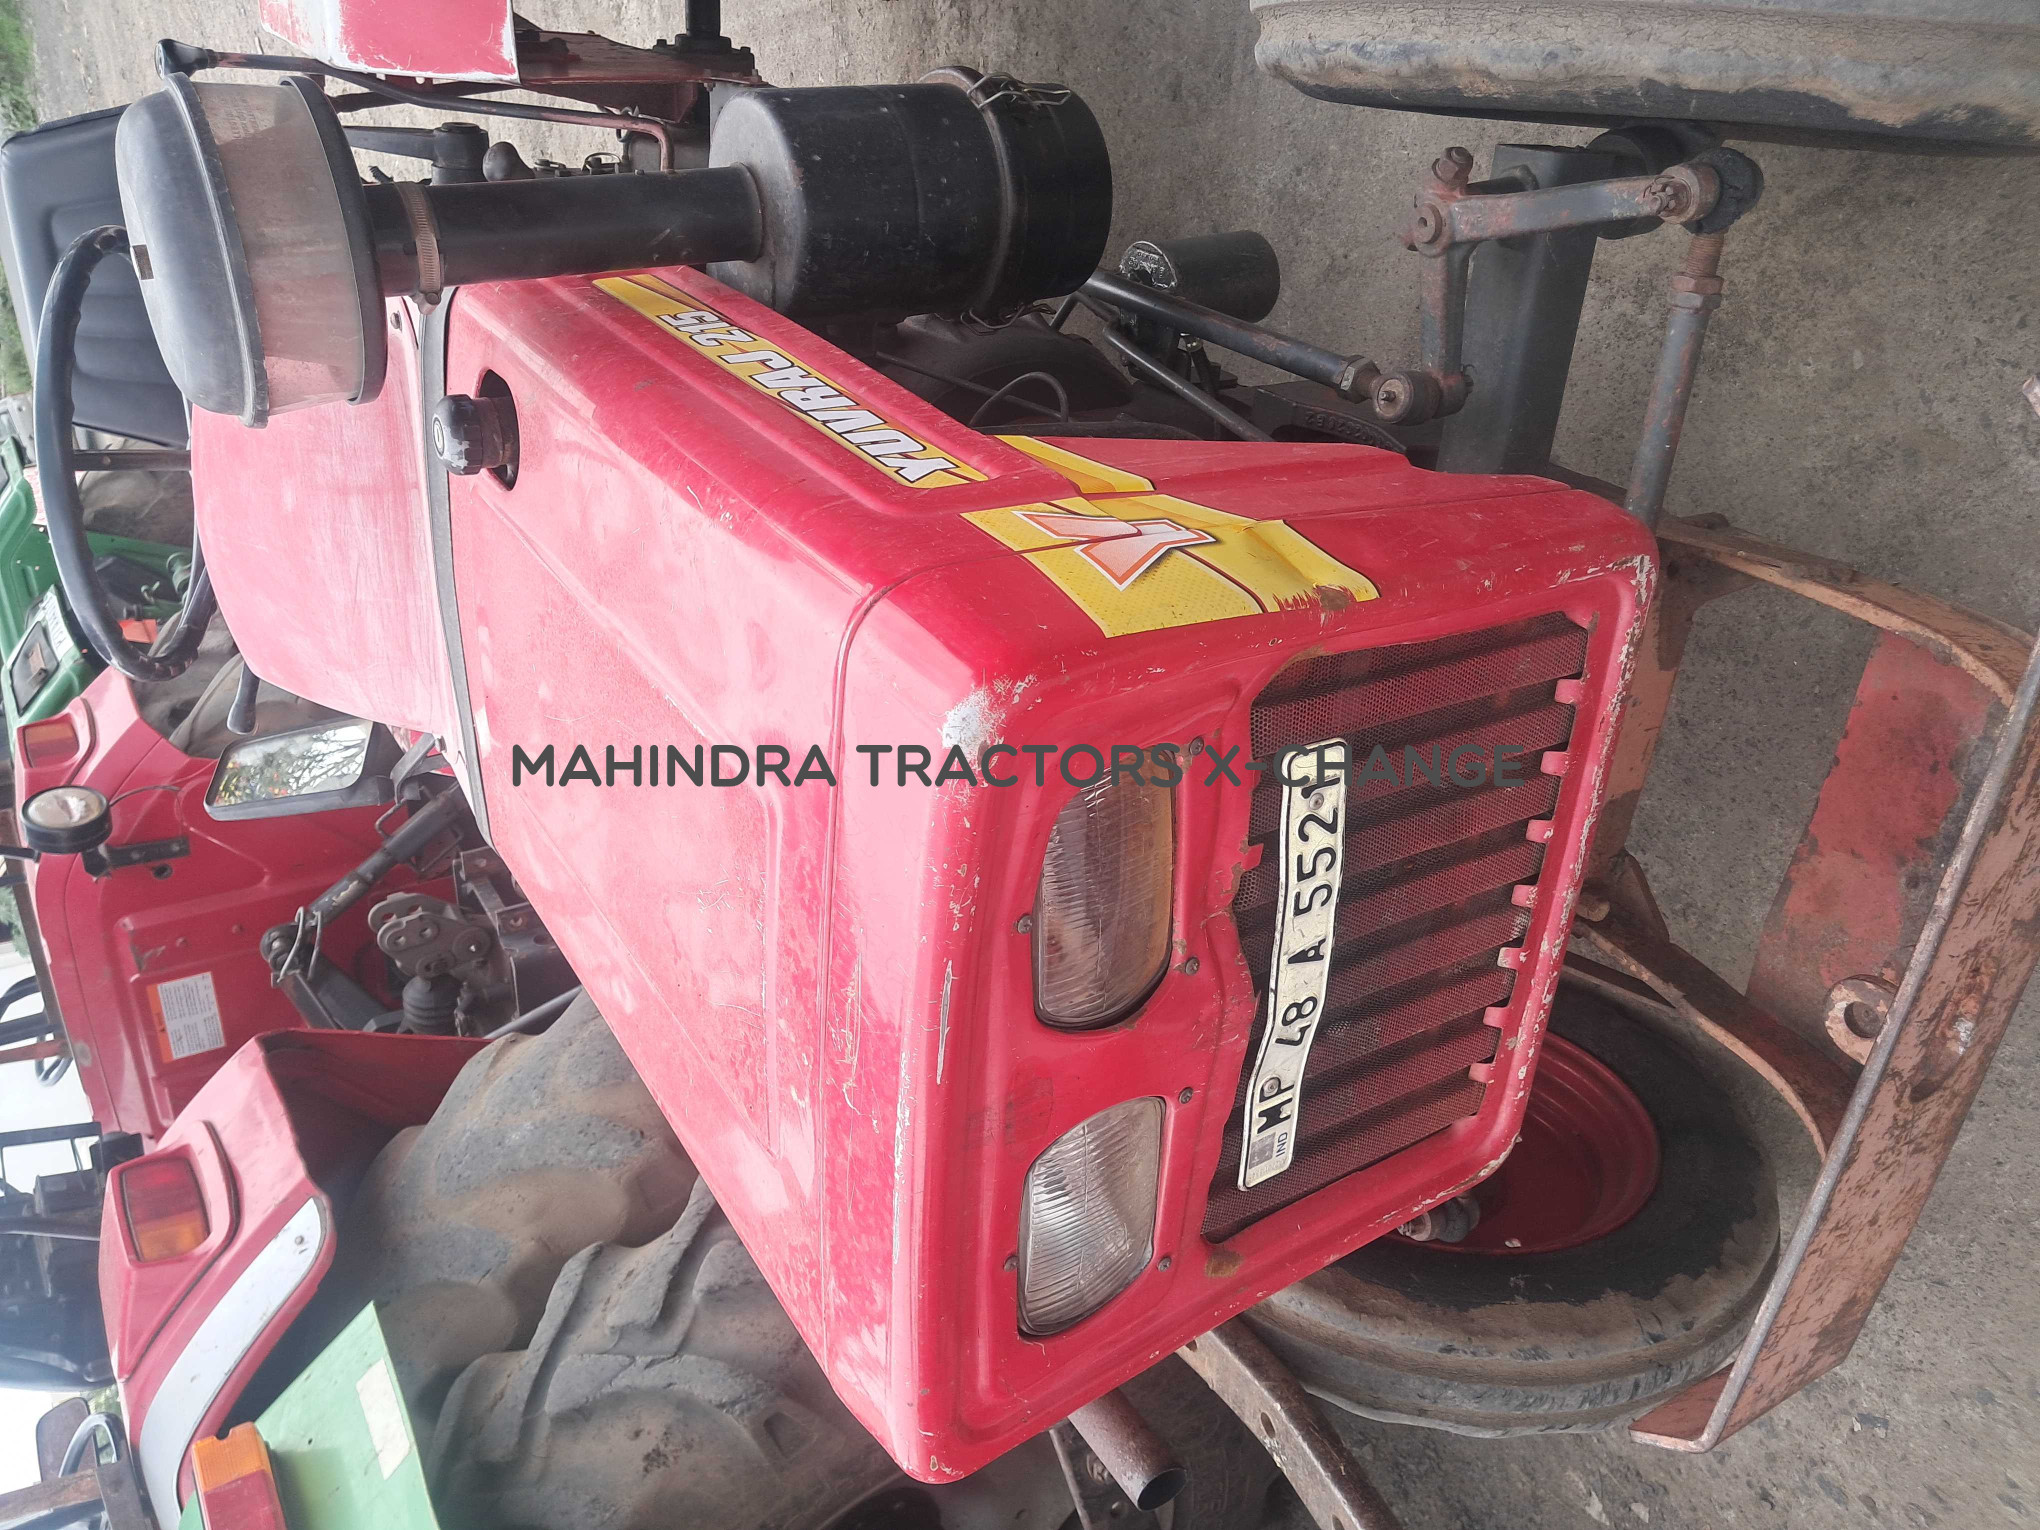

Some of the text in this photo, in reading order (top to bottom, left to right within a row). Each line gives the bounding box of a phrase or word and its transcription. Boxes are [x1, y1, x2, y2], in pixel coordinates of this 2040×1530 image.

[659, 308, 958, 482] YUVRAJ 215
[1256, 777, 1340, 1133] MP 48 A 5521
[1274, 1131, 1288, 1158] IND
